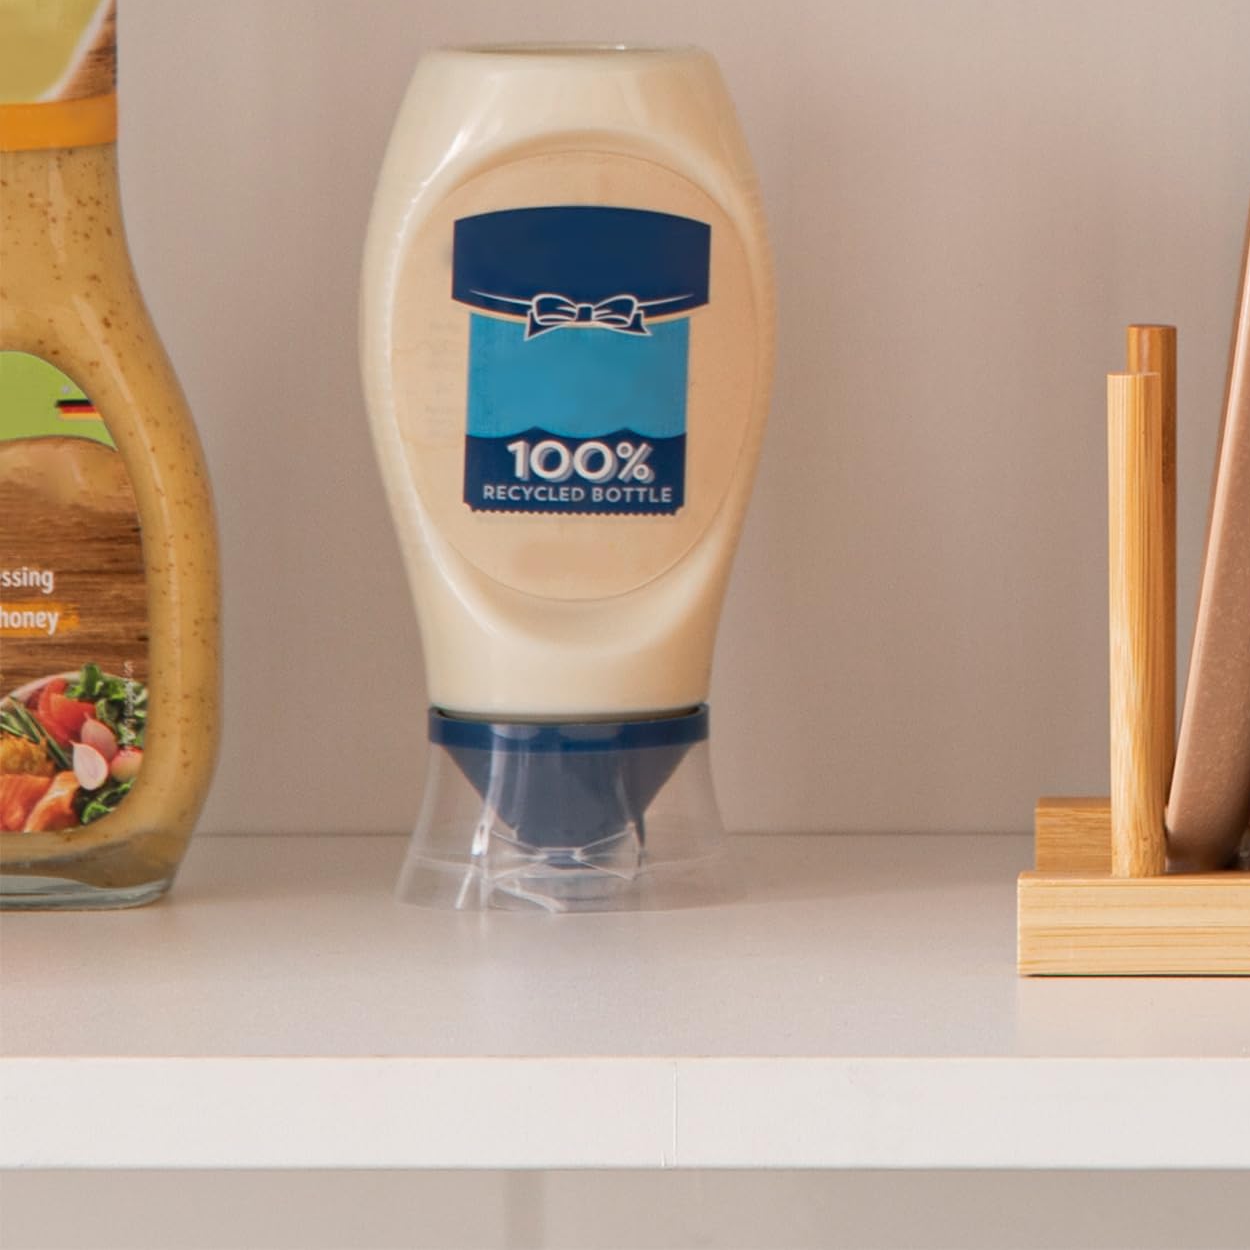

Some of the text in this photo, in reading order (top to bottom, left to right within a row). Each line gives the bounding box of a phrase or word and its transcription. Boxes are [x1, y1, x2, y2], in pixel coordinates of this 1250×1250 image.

[507, 440, 655, 483] 100%
[483, 485, 672, 502] RECYCLED BOTTLE
[0, 566, 54, 594] ssing
[0, 605, 59, 636] honey
